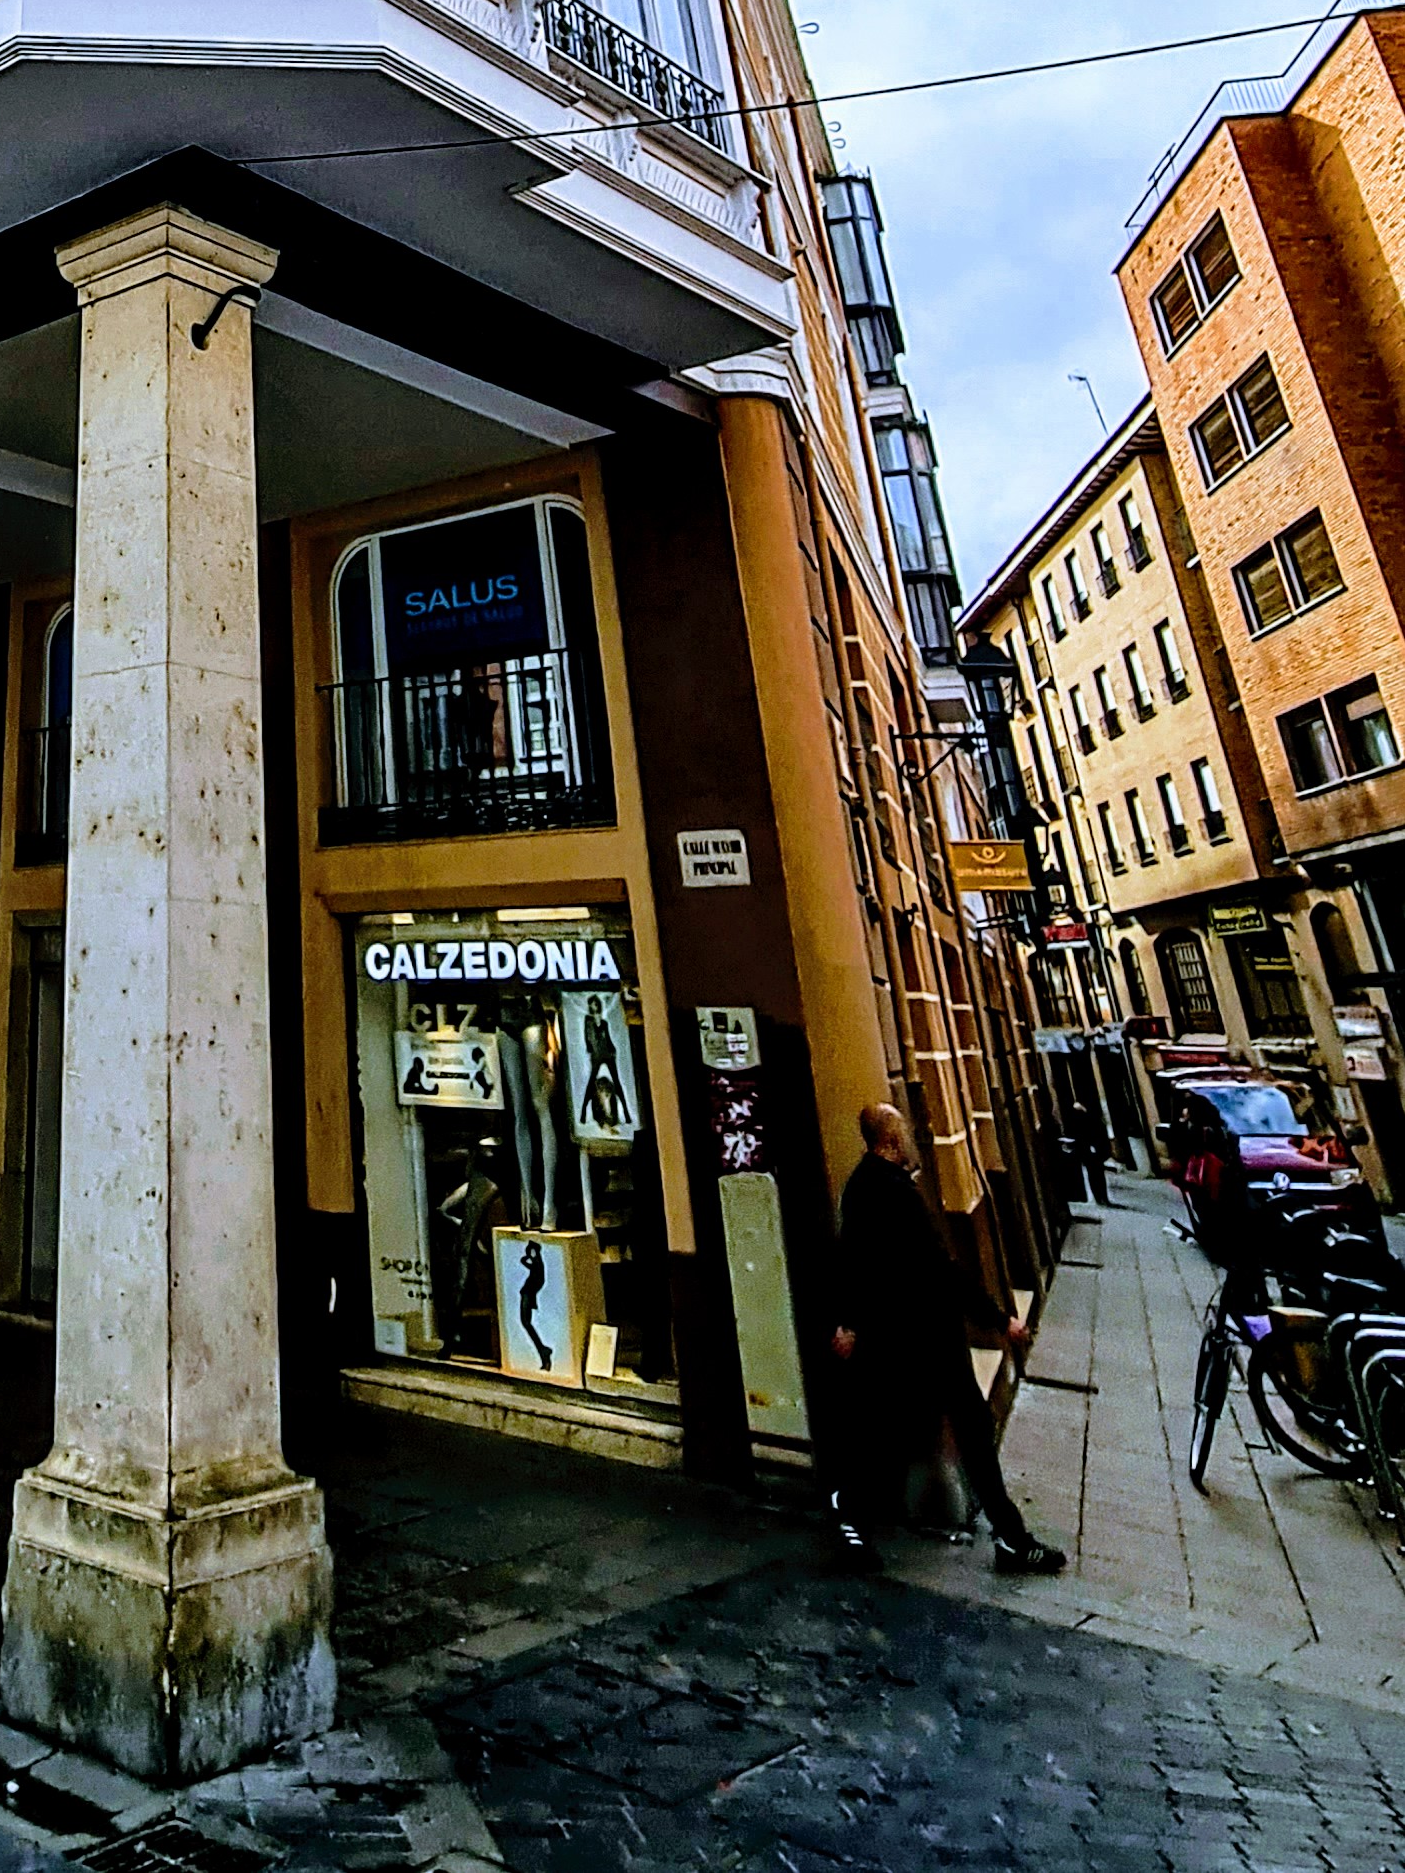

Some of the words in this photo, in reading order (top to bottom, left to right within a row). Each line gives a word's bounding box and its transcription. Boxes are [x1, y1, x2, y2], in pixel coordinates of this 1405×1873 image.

[404, 574, 520, 616] SALUS
[683, 840, 709, 855] CALLE
[365, 940, 621, 982] CALZEDONIA
[410, 1003, 480, 1033] CLZ
